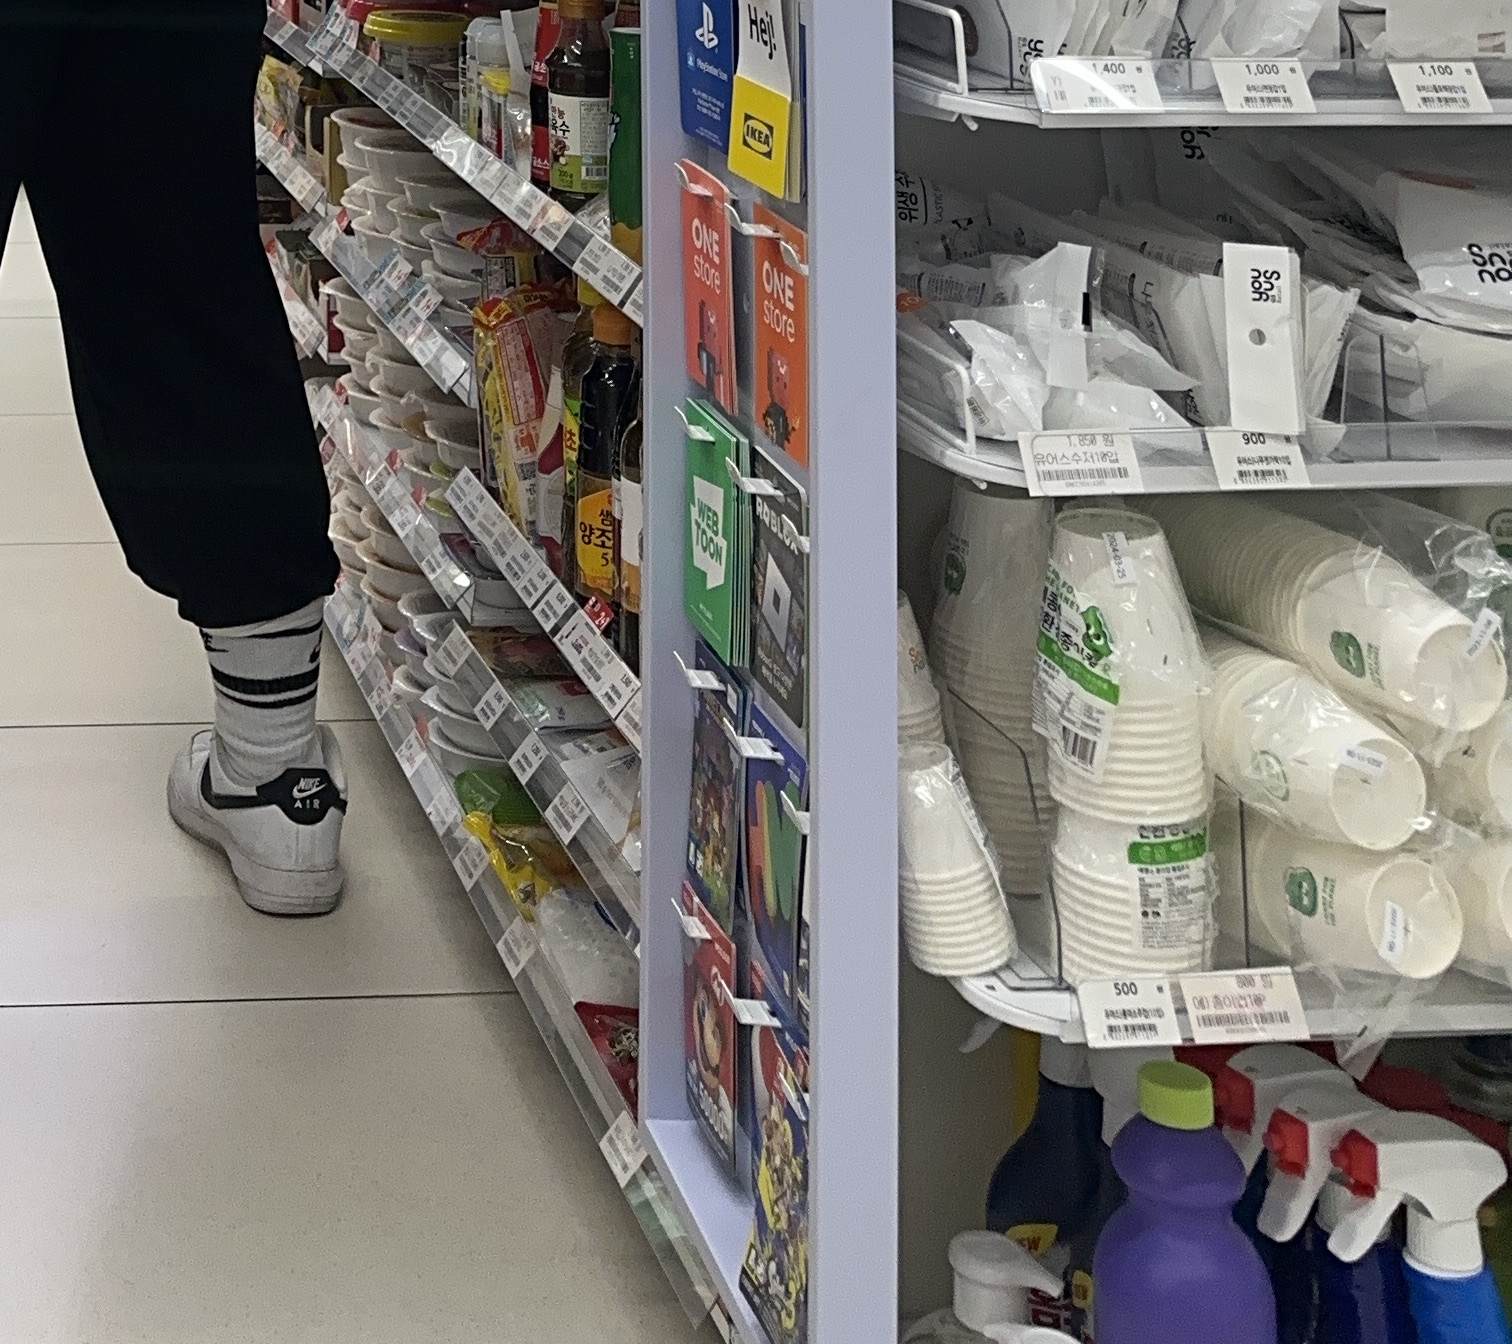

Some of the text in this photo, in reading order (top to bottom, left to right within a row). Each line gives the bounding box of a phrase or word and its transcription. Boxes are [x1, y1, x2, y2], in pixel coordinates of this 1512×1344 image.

[748, 3, 778, 61] Hej!
[1091, 62, 1126, 75] 1,400
[1245, 63, 1280, 76] 1,000
[1418, 63, 1453, 76] 1,100
[744, 123, 772, 150] IKEA
[691, 217, 720, 266] ONE
[693, 254, 721, 296] store
[762, 259, 795, 313] ONE
[762, 296, 796, 345] store
[1242, 433, 1266, 445] 900
[696, 499, 720, 538] WEB
[694, 517, 723, 568] TOON
[297, 777, 321, 791] NIKE
[293, 799, 320, 810] AIR
